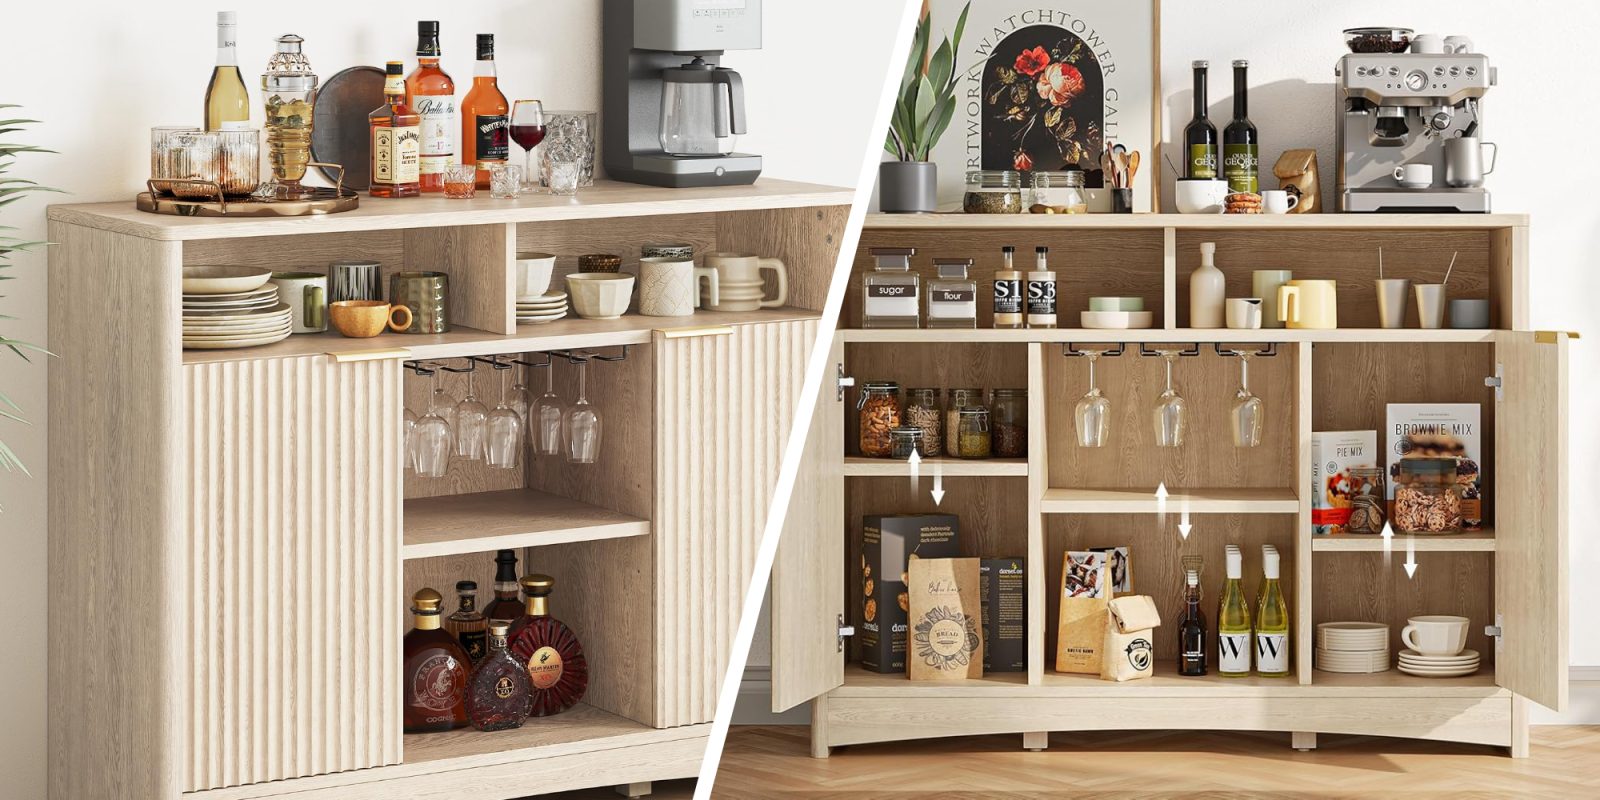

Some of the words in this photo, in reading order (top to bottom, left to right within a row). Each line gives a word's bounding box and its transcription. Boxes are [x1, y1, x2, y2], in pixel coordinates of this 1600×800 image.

[967, 69, 981, 169] RTWORK
[975, 9, 1116, 77] WATCHTOWER
[1105, 88, 1118, 145] GALL
[879, 286, 905, 296] sugar
[944, 292, 962, 300] flour
[995, 280, 1021, 298] S1
[1028, 281, 1056, 299] S3
[1395, 423, 1446, 436] BROWNIE
[1452, 423, 1472, 436] MIX
[1336, 447, 1347, 457] PIE
[1350, 446, 1363, 457] MIX
[1220, 636, 1245, 660] W
[1257, 636, 1283, 660] W
